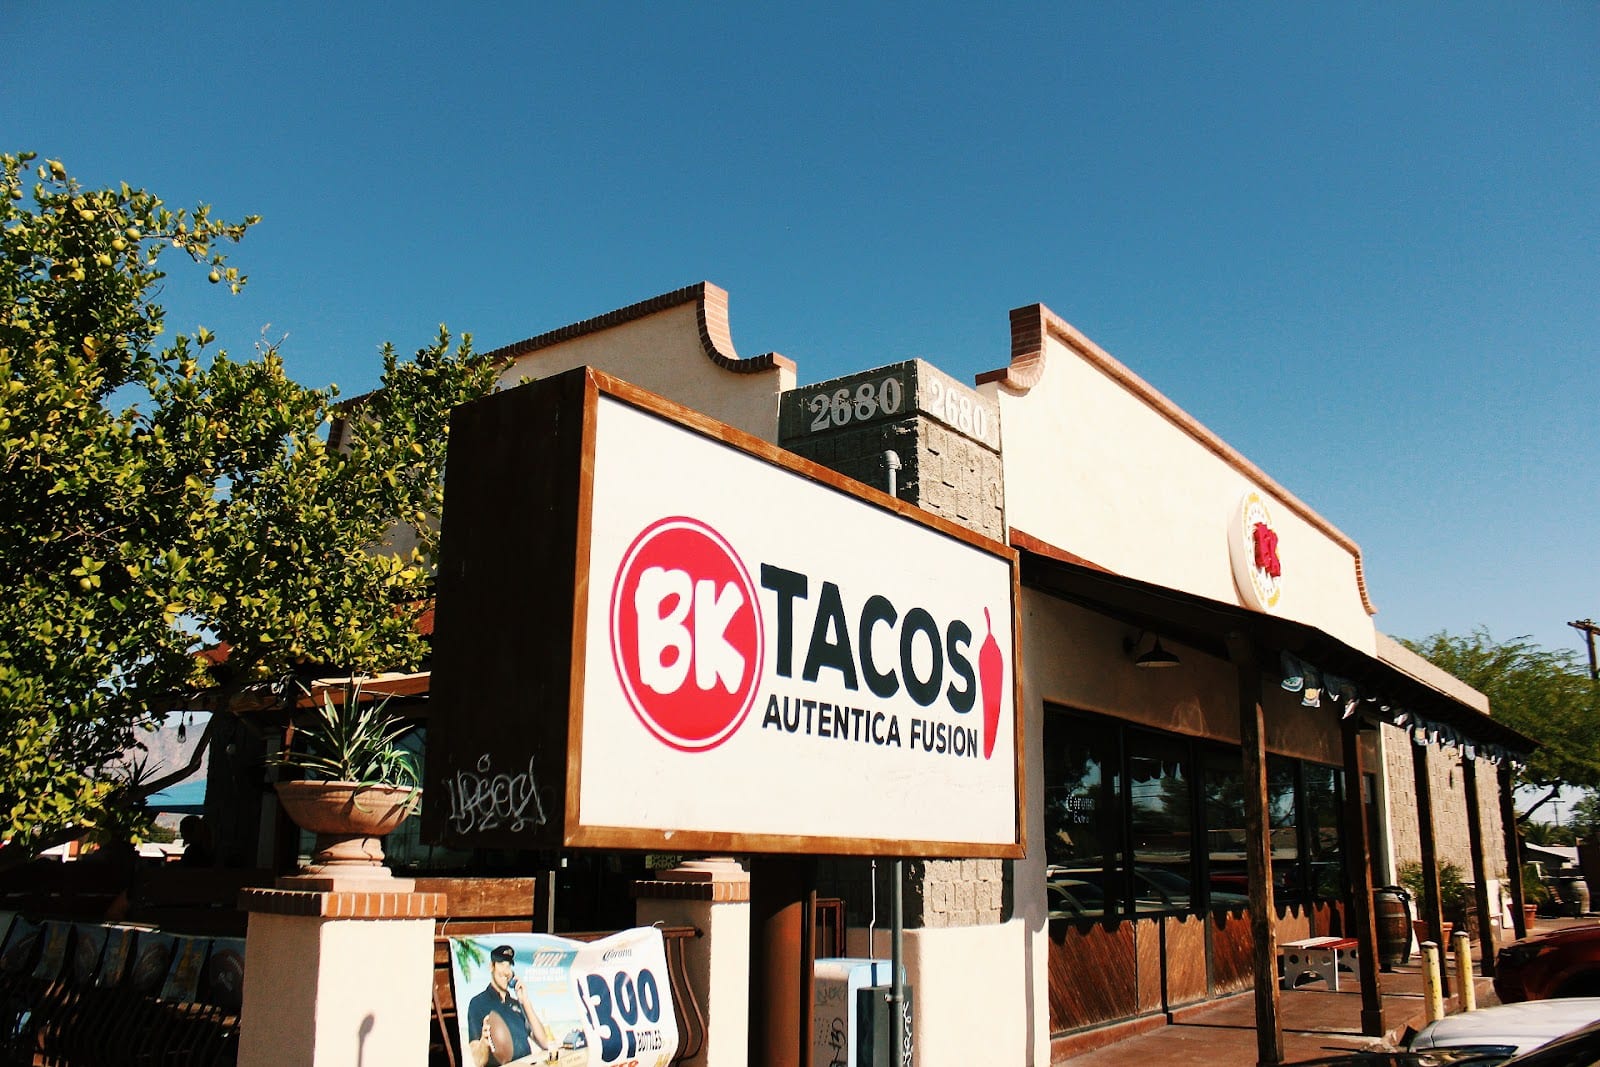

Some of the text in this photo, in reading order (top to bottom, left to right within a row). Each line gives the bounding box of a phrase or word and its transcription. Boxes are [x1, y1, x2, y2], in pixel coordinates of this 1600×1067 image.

[808, 377, 901, 433] 2680
[931, 376, 988, 440] 2680
[635, 563, 977, 714] BK TACOS
[762, 694, 978, 759] AUTENTICA FUSION
